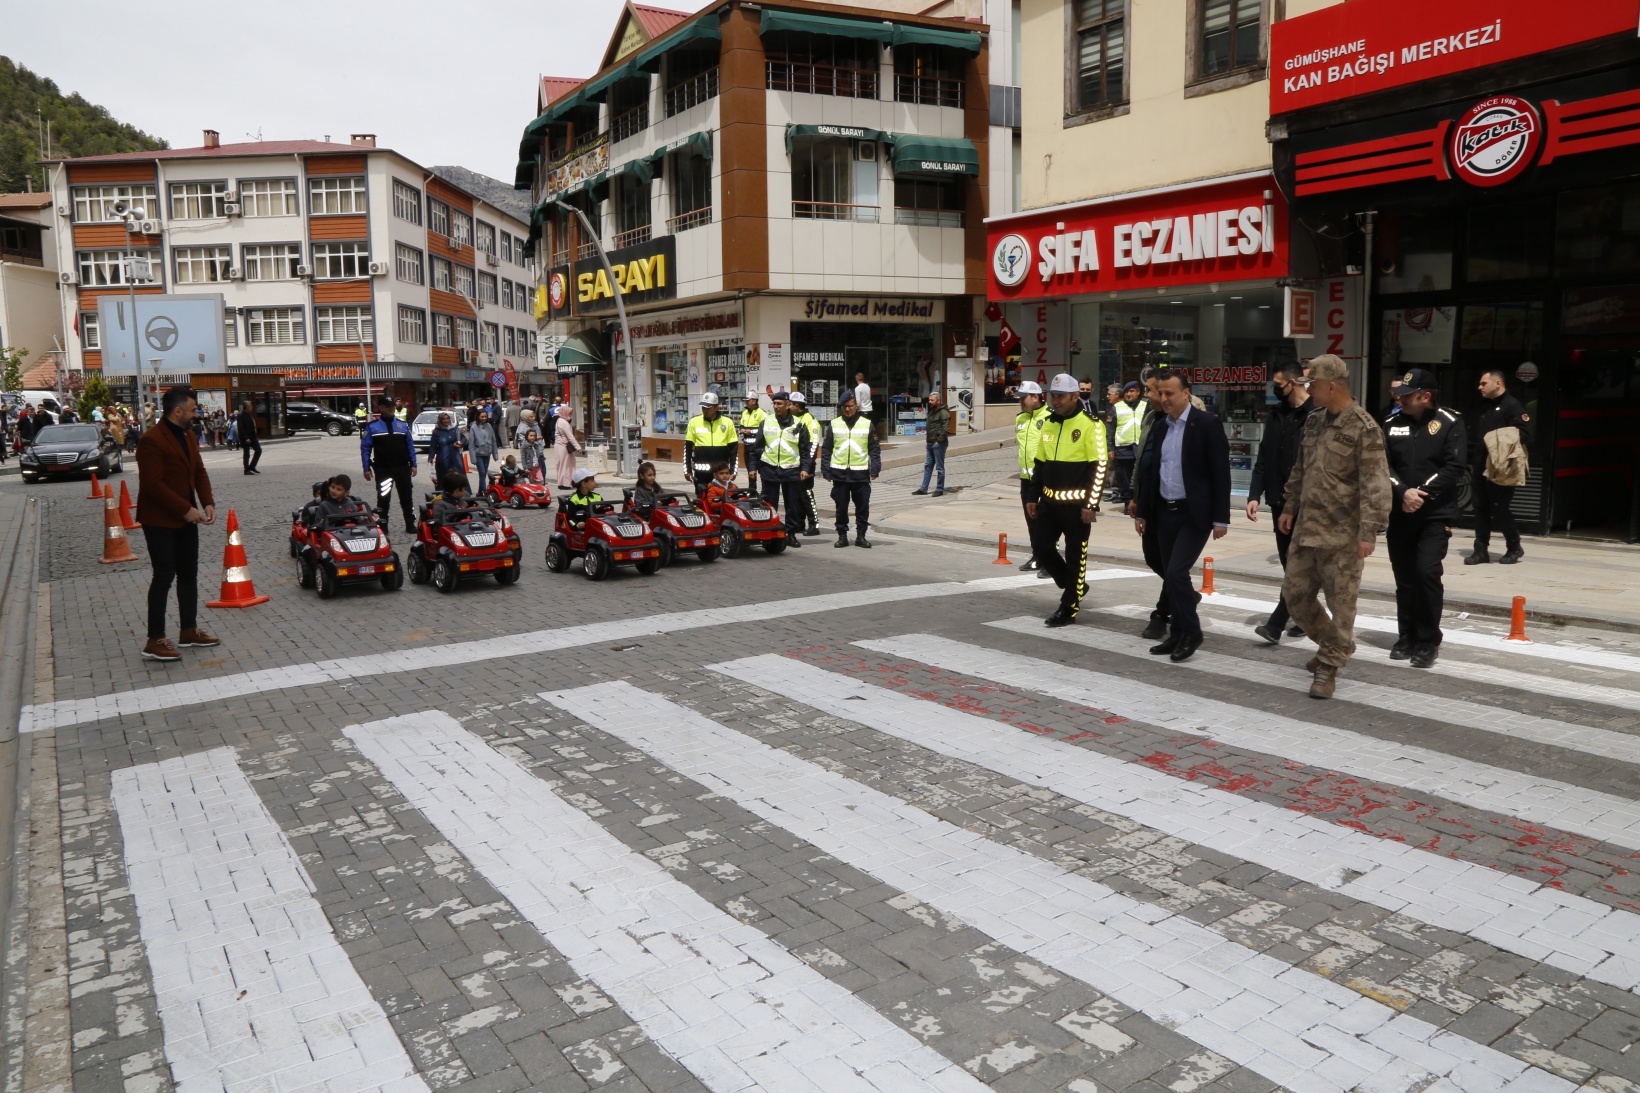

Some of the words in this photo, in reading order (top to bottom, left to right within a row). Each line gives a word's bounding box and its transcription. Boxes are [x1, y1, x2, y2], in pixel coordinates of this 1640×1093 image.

[1283, 70, 1322, 94] KAN
[1327, 54, 1395, 83] BAĞIŞI
[1401, 19, 1502, 65] MERKEZİ
[1284, 39, 1366, 71] GÜMÜŞHANE
[1473, 98, 1499, 114] SINCE
[1501, 97, 1518, 106] 1988
[818, 126, 840, 135] GÖNÜL
[841, 128, 864, 137] SARAYI
[1496, 140, 1518, 165] DÖNER
[921, 161, 942, 170] GÖNÜL
[943, 163, 966, 171] SARAYI
[1038, 222, 1100, 282] ŞİFA
[1113, 190, 1275, 268] ECZANESİ
[578, 254, 666, 303] SARAYI
[805, 299, 869, 319] Şifamed
[873, 302, 934, 317] Medikal
[1193, 362, 1267, 384] ECZANESİ
